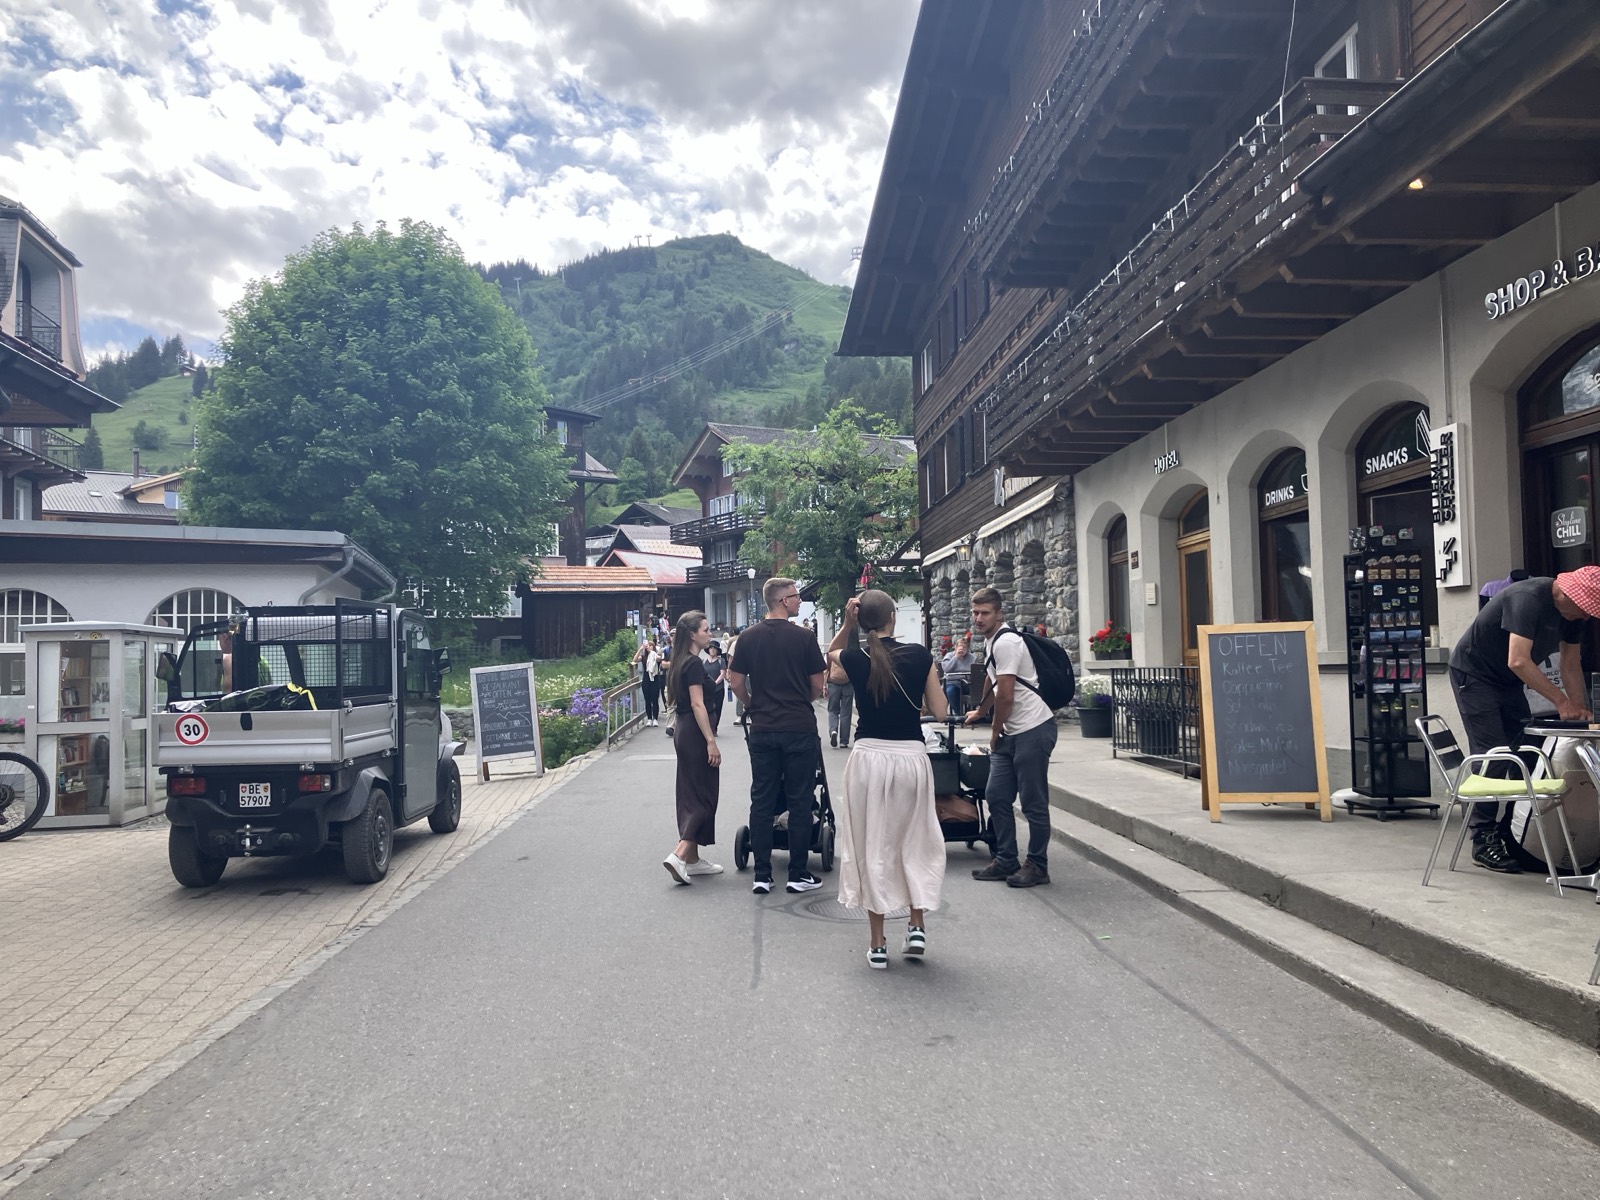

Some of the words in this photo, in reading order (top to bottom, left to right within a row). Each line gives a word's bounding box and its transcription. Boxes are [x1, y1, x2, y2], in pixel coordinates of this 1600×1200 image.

[1485, 270, 1545, 320] SHOP
[1551, 259, 1570, 289] &
[1154, 450, 1180, 474] HOTEL
[1365, 447, 1409, 475] SNACKS
[1265, 485, 1295, 506] DRINKS
[1556, 524, 1582, 539] CHILL
[1218, 634, 1287, 657] OFFEN
[1268, 658, 1293, 674] Tee
[482, 681, 520, 692] RESTAURANT
[183, 724, 201, 737] 30
[248, 784, 261, 795] BE
[240, 795, 269, 806] 57907
